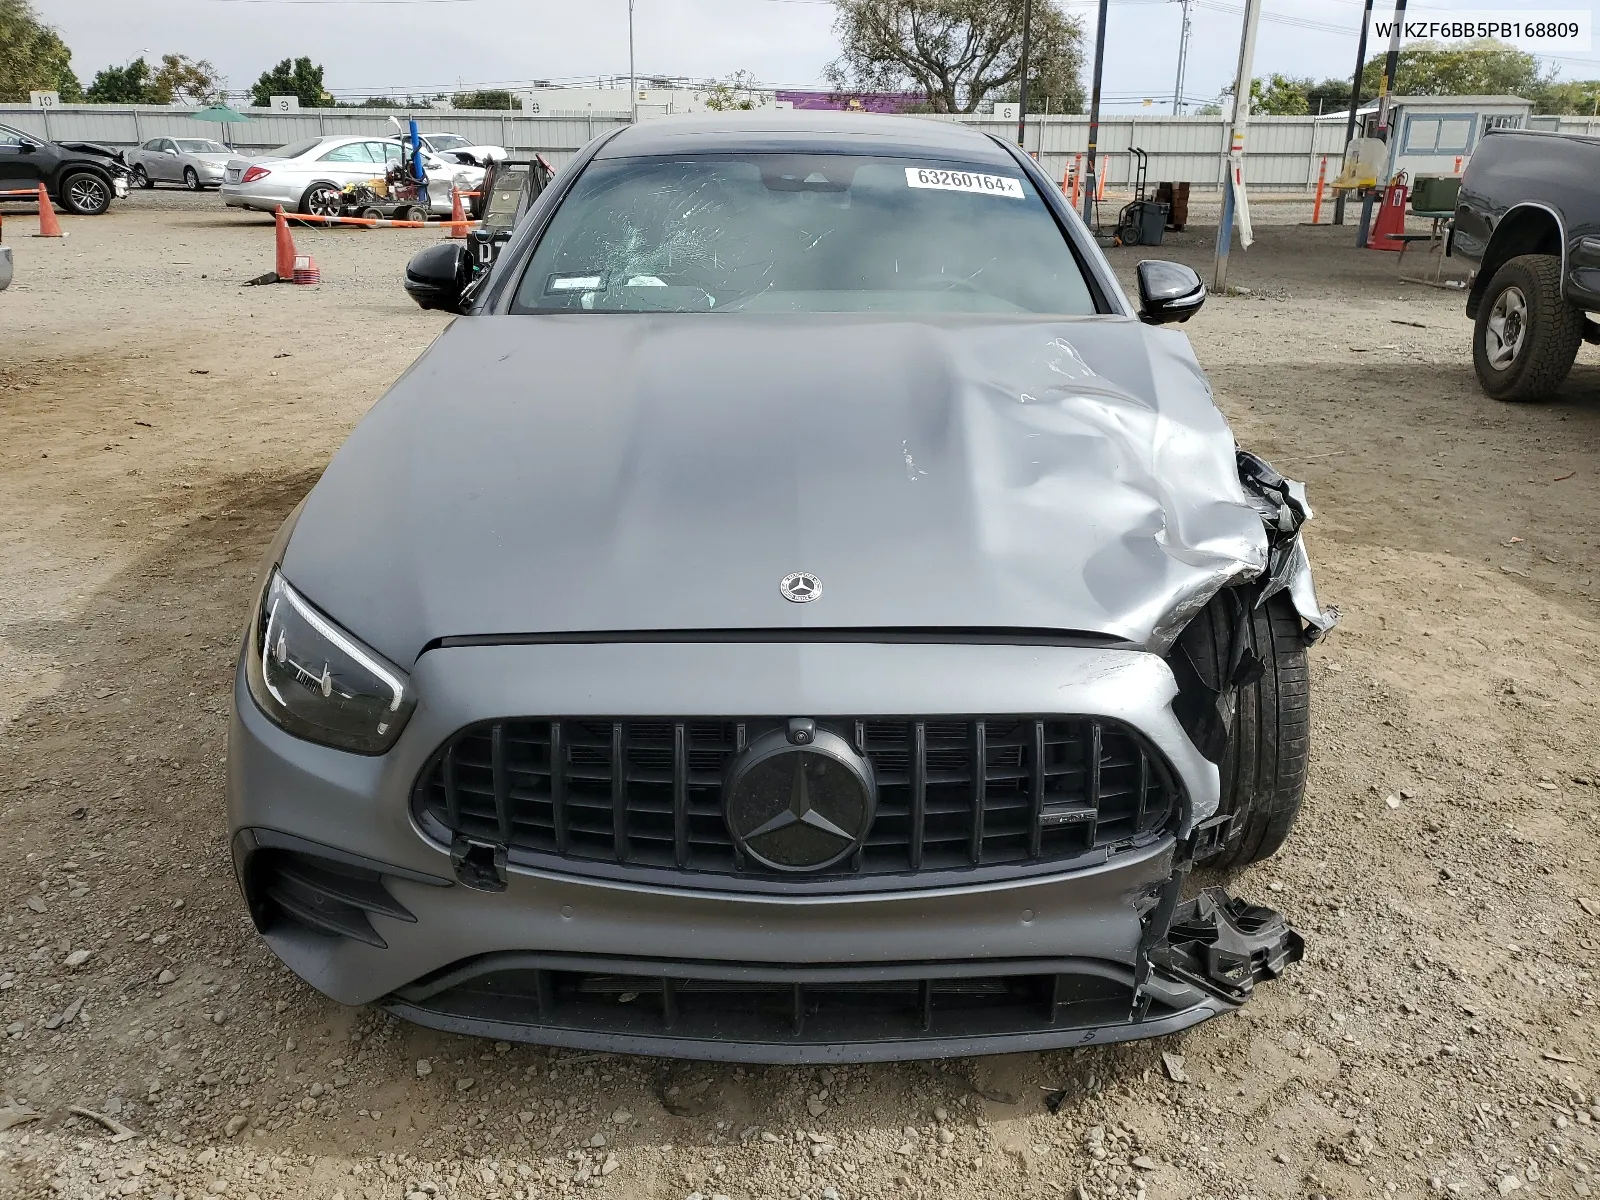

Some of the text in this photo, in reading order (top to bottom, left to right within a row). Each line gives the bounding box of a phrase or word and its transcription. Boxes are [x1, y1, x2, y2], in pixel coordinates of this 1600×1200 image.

[39, 96, 52, 106] 10
[281, 101, 288, 111] 9
[1004, 108, 1011, 118] 6
